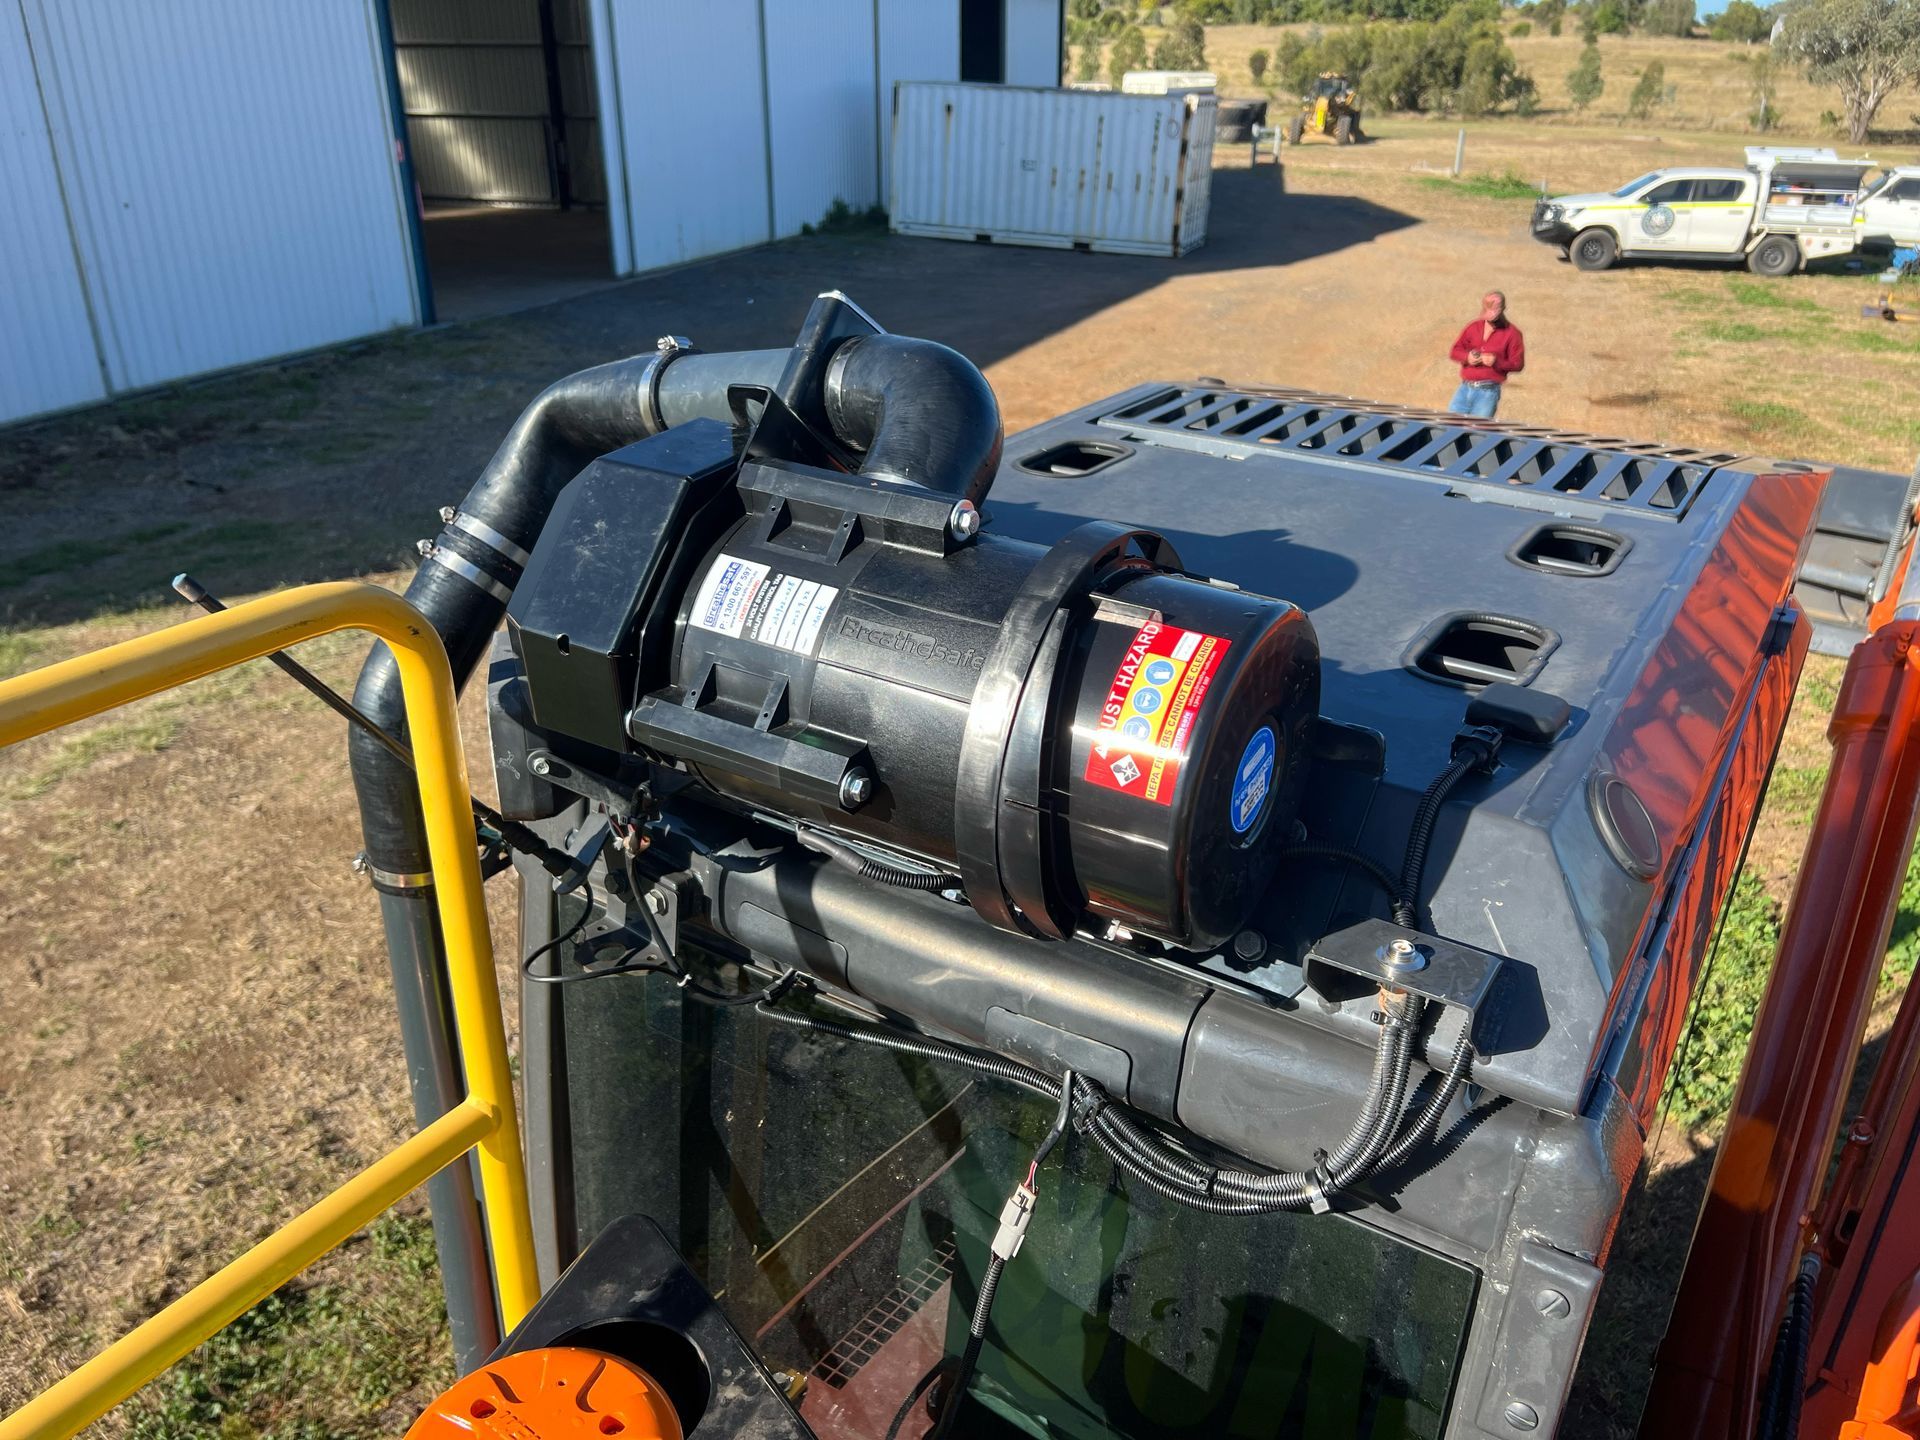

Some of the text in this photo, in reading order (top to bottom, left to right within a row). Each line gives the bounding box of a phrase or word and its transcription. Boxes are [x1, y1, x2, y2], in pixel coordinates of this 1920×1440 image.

[724, 598, 736, 617] 1300
[733, 582, 743, 597] 667
[741, 567, 752, 580] 597
[746, 579, 761, 602] HAZARD
[750, 605, 760, 620] VOLT
[757, 579, 771, 604] SYSTEM
[750, 613, 764, 639] QUALITY
[760, 588, 777, 613] CONTROL
[839, 615, 986, 672] Breathesafe
[1099, 622, 1161, 730] UST HAZARD
[1148, 772, 1161, 798] HEPA
[1168, 688, 1188, 727] CANNOT
[1183, 673, 1195, 687] BE
[1191, 638, 1215, 673] CLEANED
